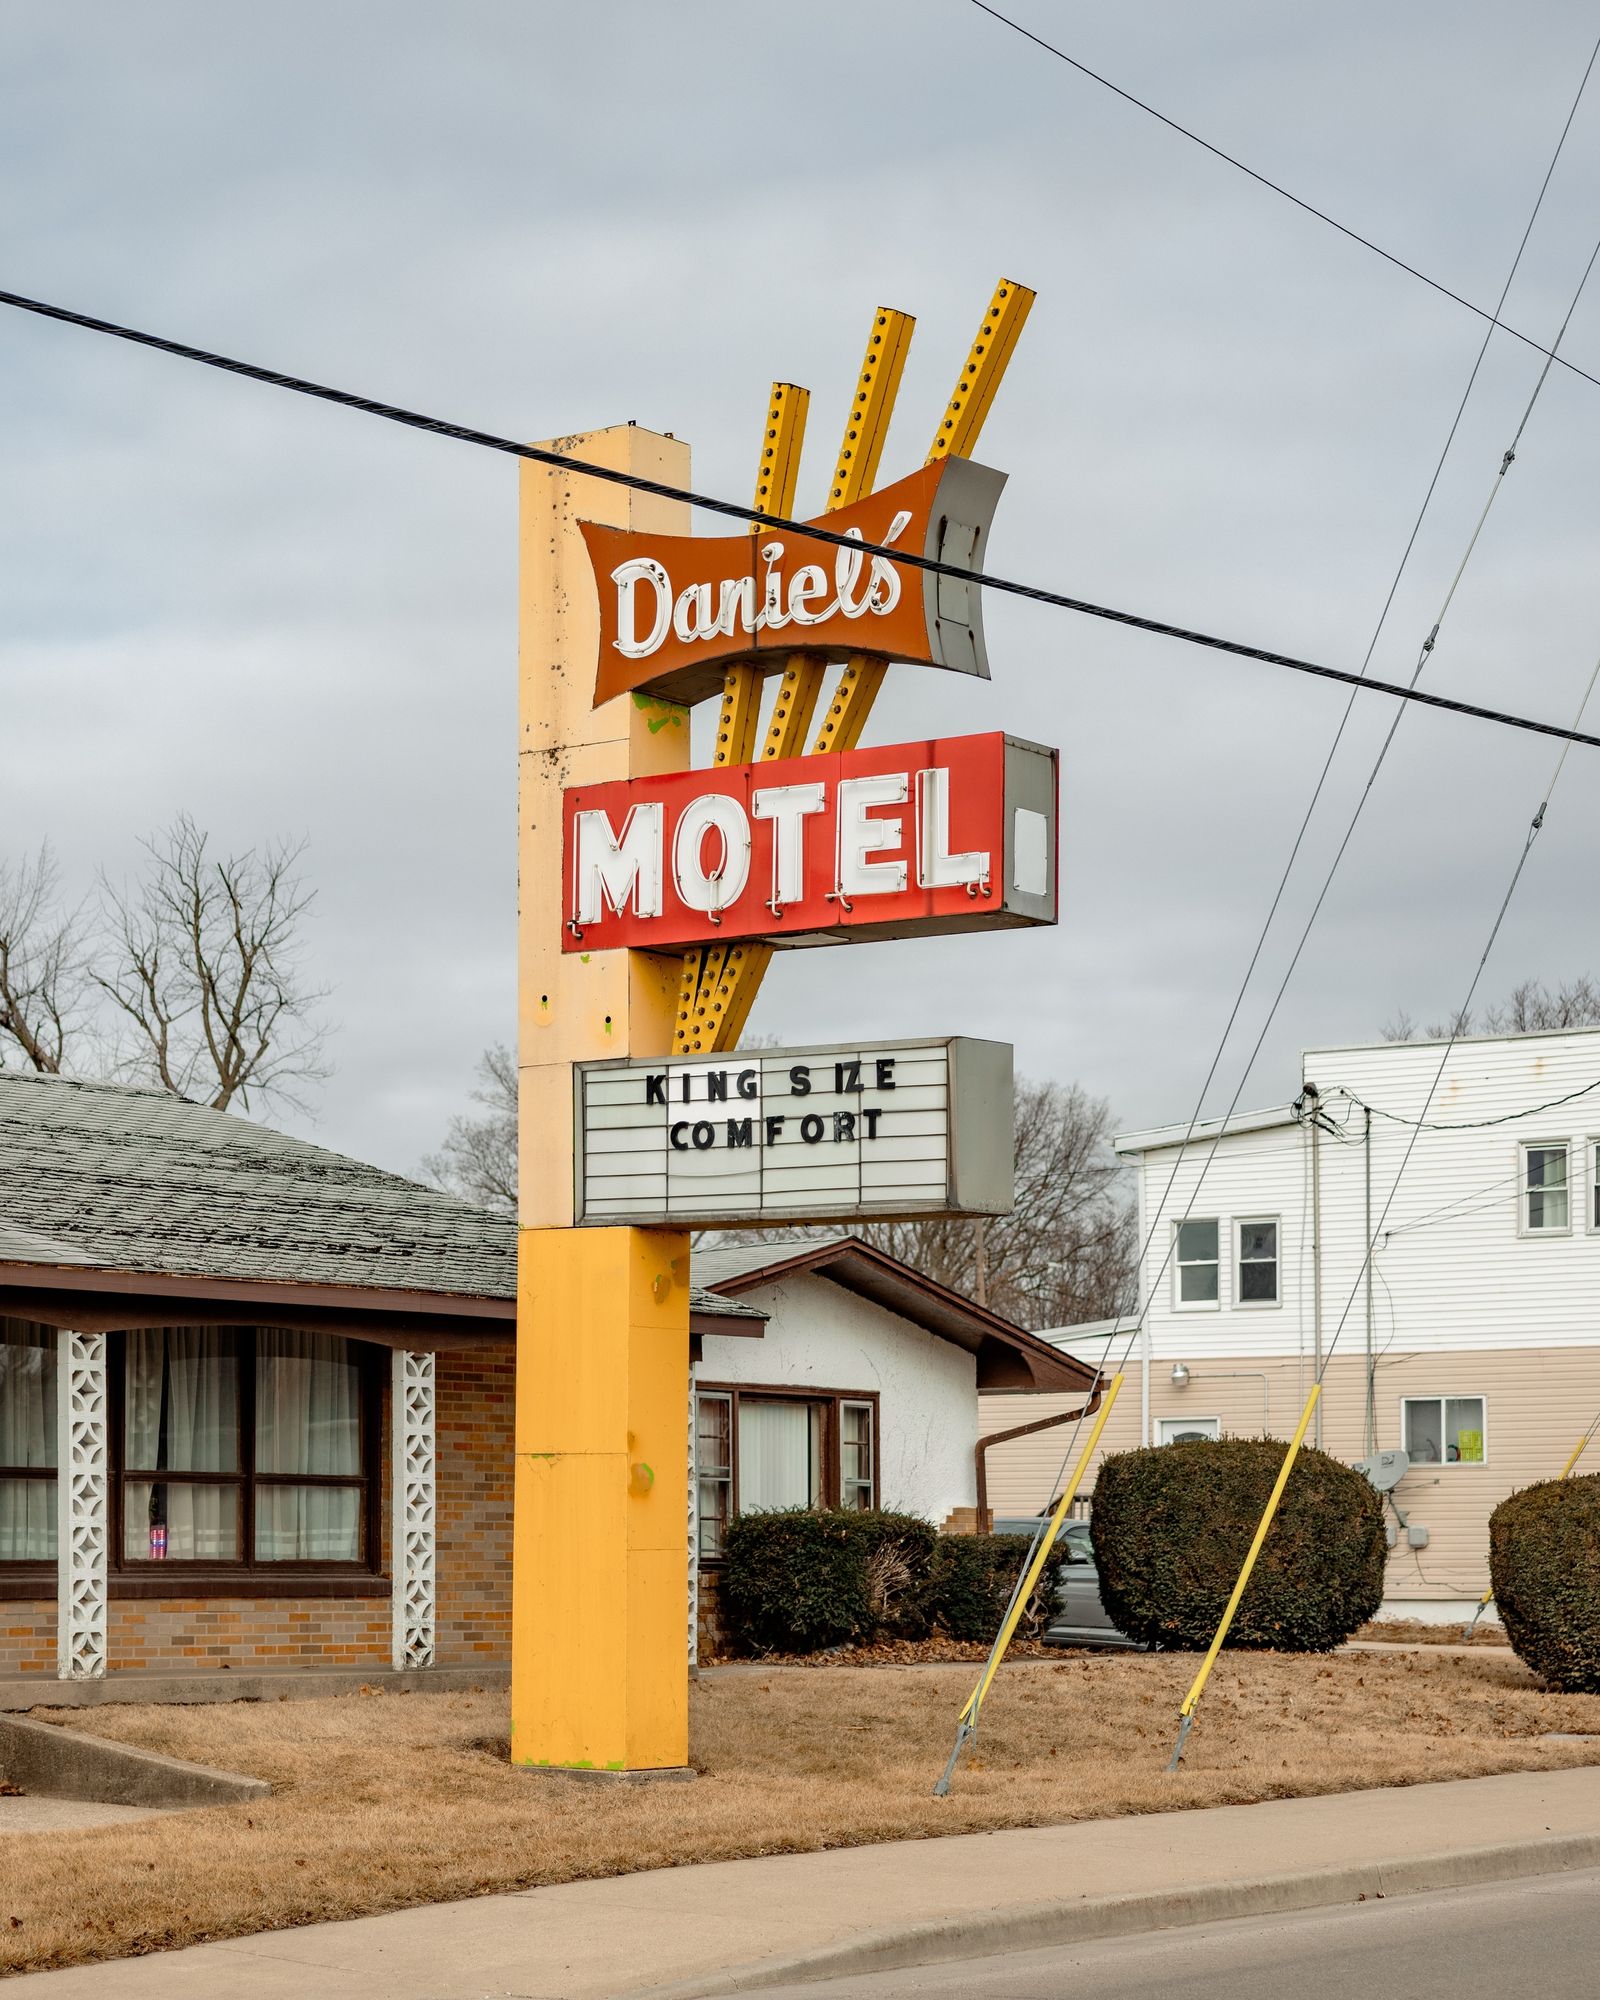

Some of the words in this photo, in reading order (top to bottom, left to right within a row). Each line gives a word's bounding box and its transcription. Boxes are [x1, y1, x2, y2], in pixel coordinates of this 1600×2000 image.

[610, 510, 913, 659] Daniel's
[571, 767, 991, 928] MOTEL
[645, 1068, 758, 1106] KING
[789, 1058, 896, 1097] SIZE
[669, 1108, 883, 1152] COMFORT
